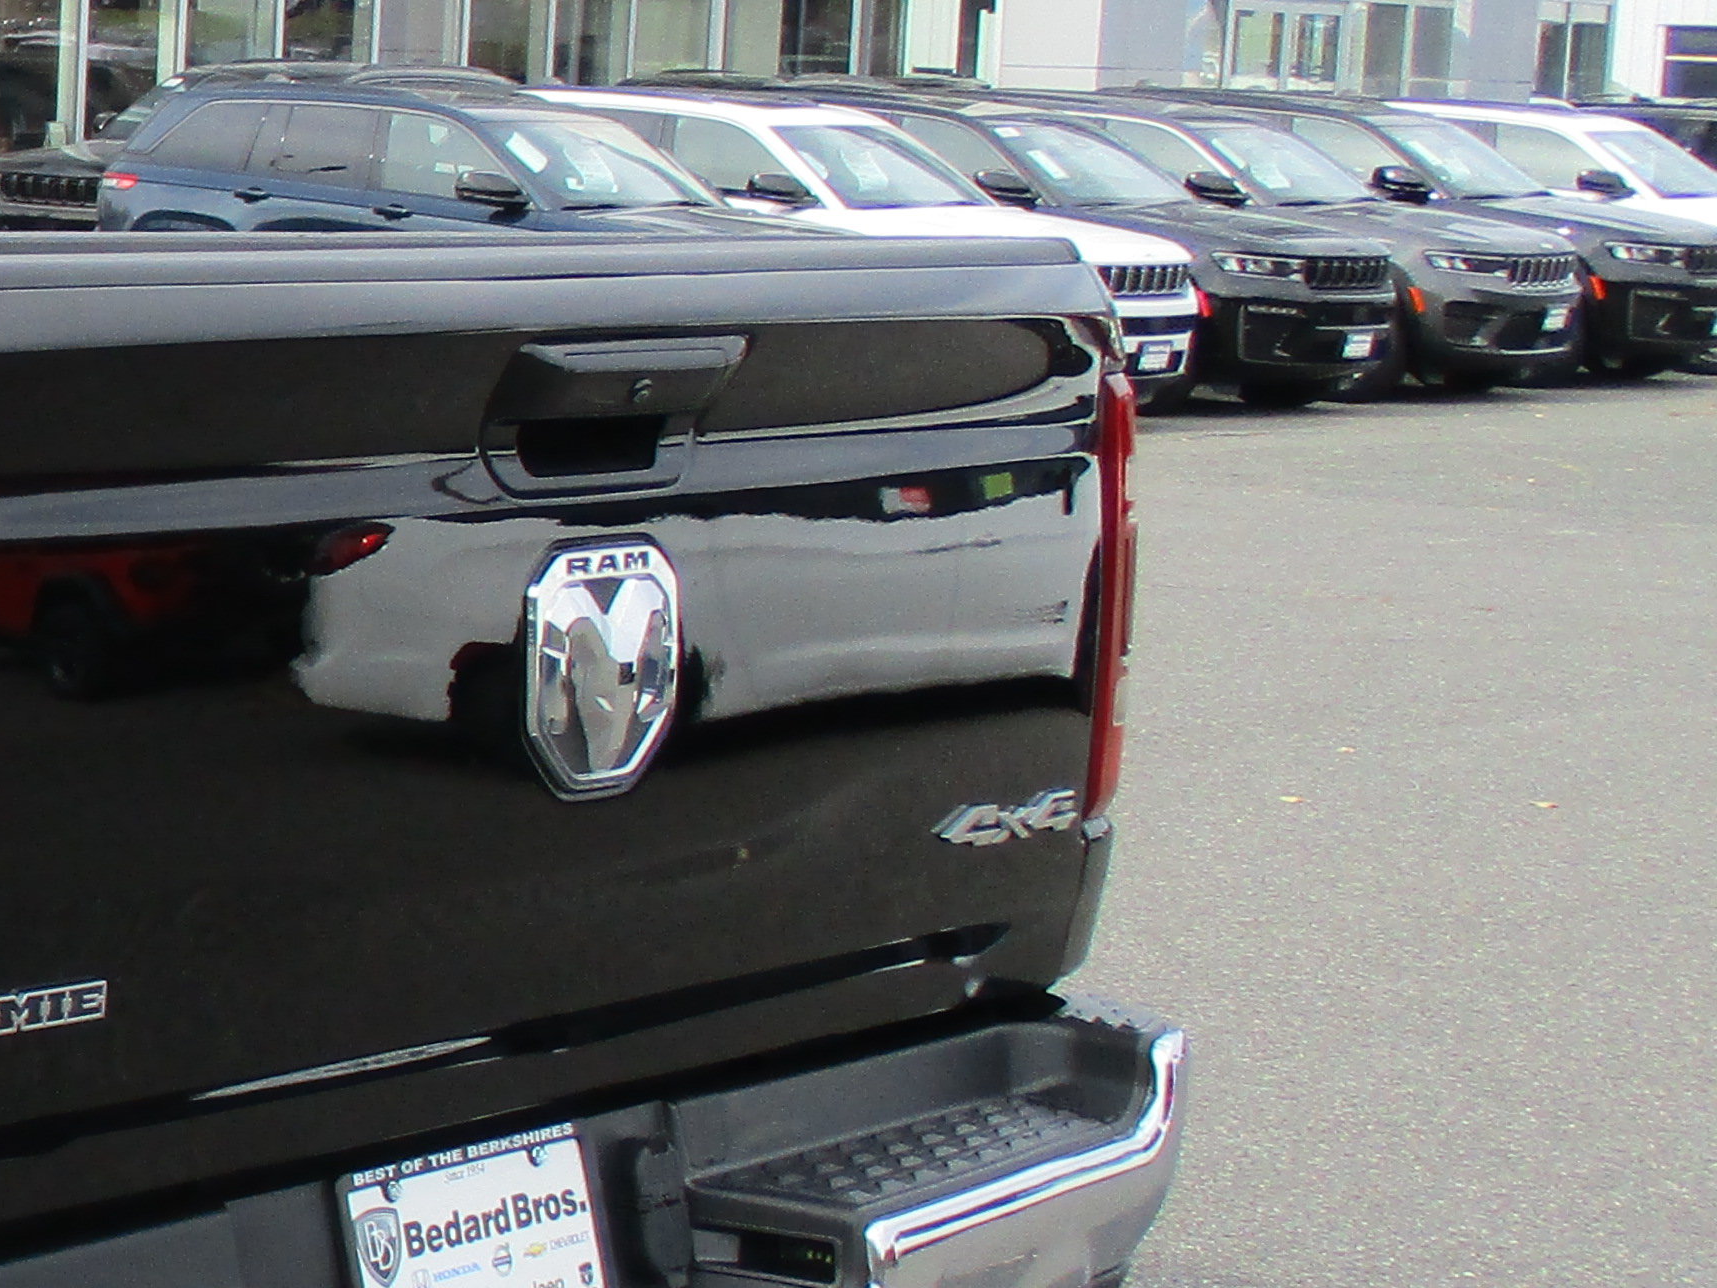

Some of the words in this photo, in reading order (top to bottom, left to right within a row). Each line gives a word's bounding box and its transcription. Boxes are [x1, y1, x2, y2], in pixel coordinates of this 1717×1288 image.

[566, 551, 650, 575] RAM
[353, 1164, 397, 1187] BEST
[401, 1157, 425, 1174] OF
[428, 1148, 463, 1167] THE
[467, 1122, 574, 1159] BERKSHIRES
[433, 1262, 482, 1283] HONDA
